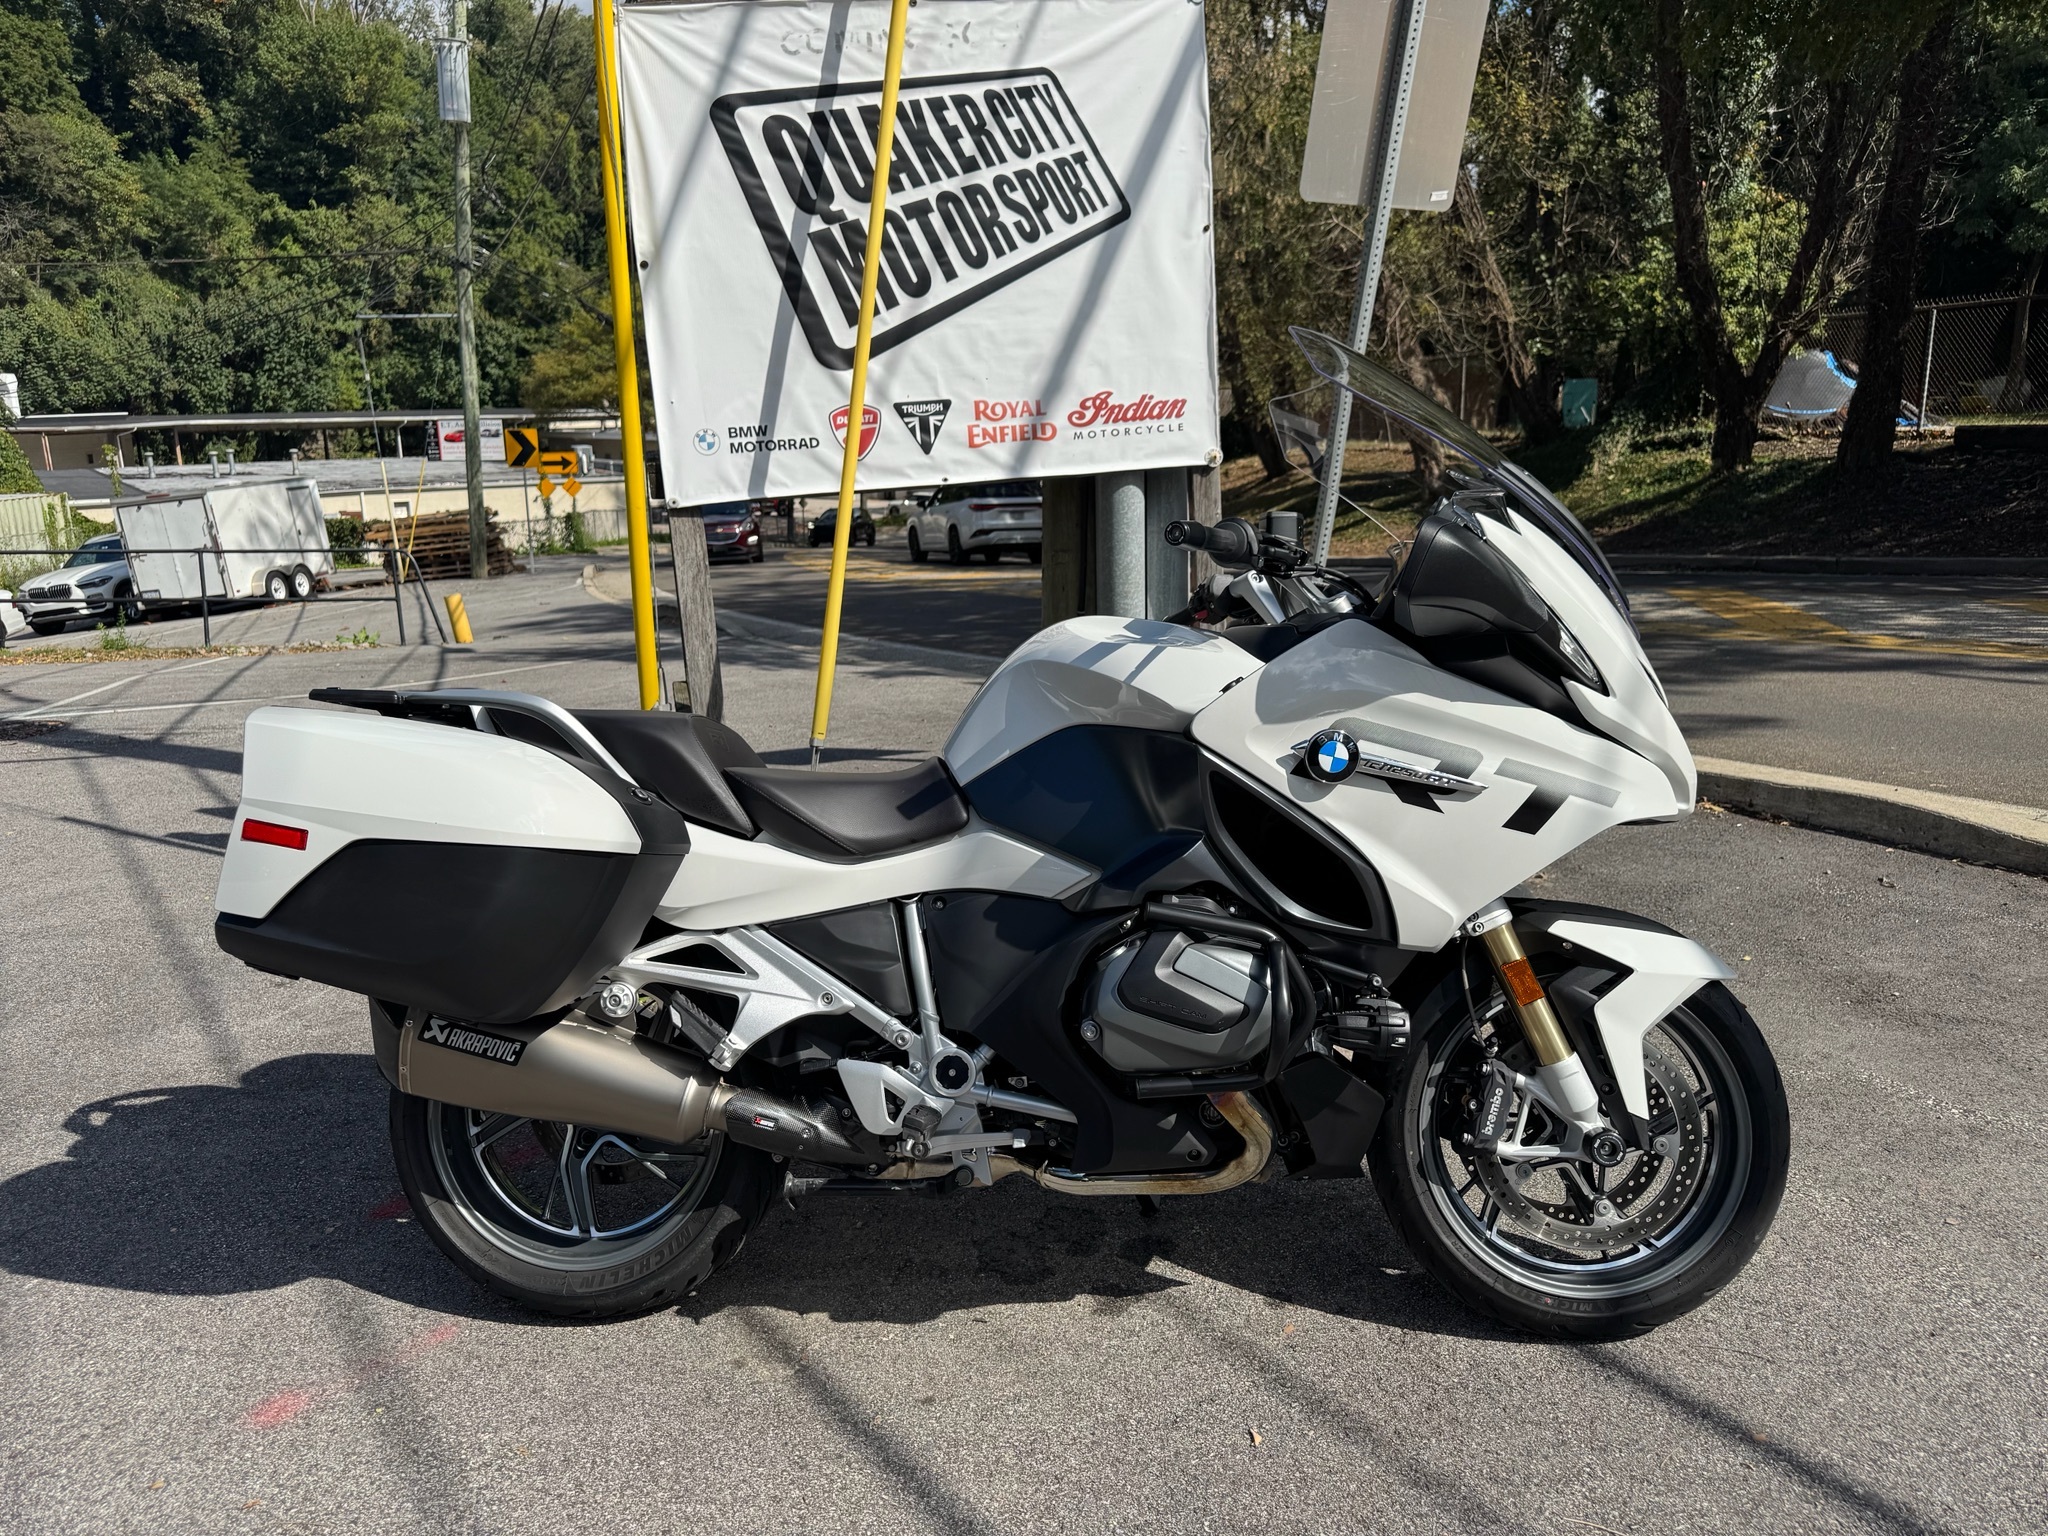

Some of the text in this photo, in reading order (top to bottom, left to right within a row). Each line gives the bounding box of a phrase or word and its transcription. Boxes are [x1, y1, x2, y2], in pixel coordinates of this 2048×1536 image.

[762, 84, 1076, 225] QUAKER CITY
[807, 151, 1109, 329] MOTORSPORT
[836, 414, 873, 424] DUTI
[902, 403, 943, 414] TRIUMPH
[974, 399, 1047, 422] ROYAL
[1067, 391, 1187, 427] Indian
[728, 425, 768, 439] BMW
[967, 422, 1057, 448] ENFIELD
[1073, 423, 1184, 440] MOTORCYCLE
[730, 437, 820, 454] MOTORRAD
[1316, 732, 1356, 753] BMW
[1481, 1087, 1504, 1136] brembo
[580, 1225, 692, 1289] MICHELIN
[1508, 1285, 1593, 1312] MICHELIN
